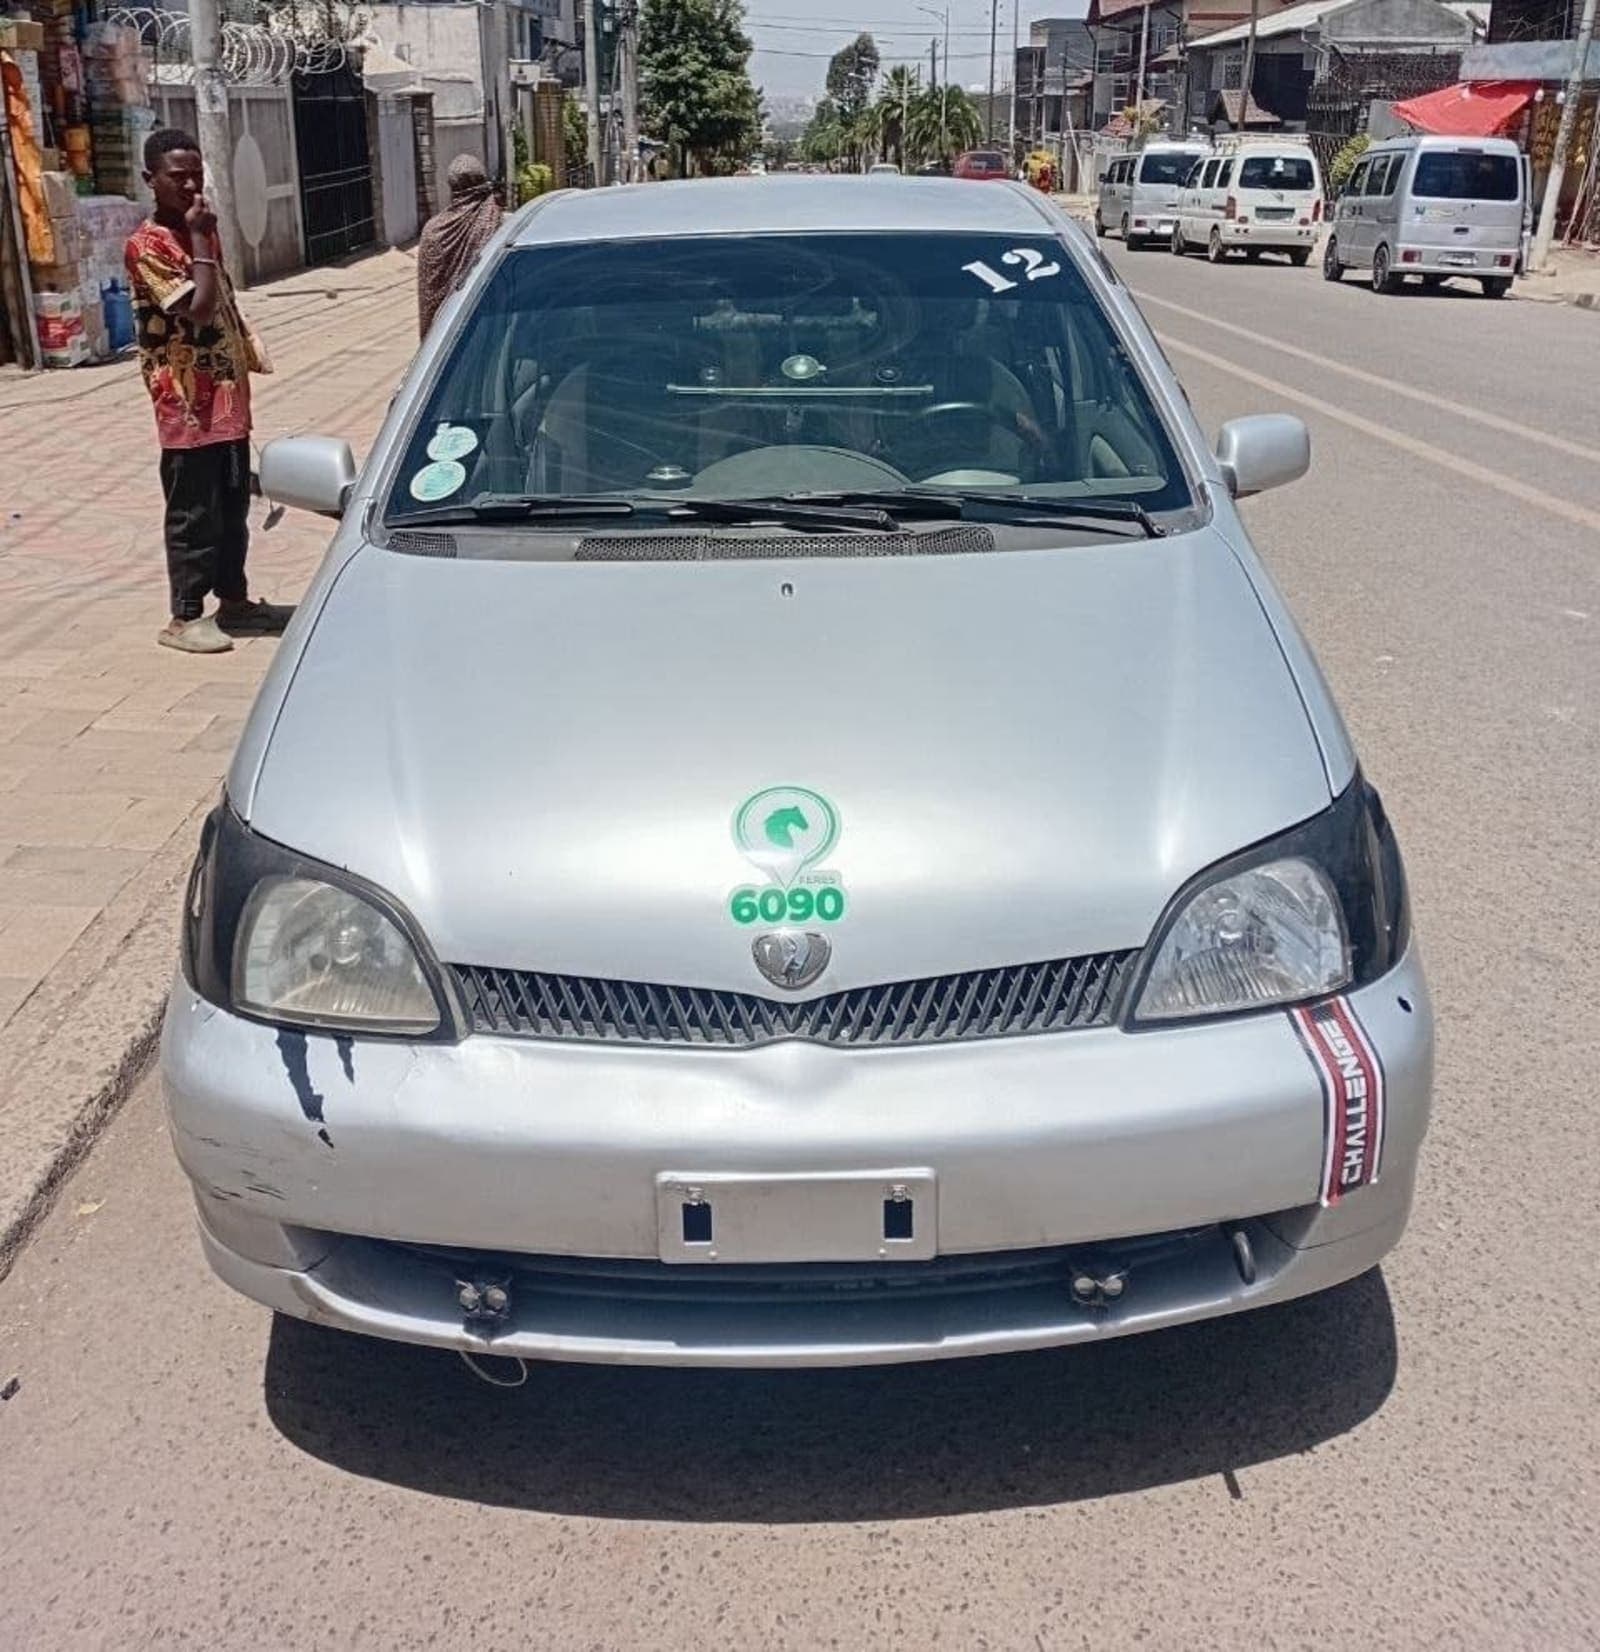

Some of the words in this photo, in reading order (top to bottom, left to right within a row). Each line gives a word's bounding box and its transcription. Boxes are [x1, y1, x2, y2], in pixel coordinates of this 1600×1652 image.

[961, 248, 1060, 292] 12
[732, 887, 844, 924] 6090
[1316, 1019, 1368, 1185] CHALLENGE
